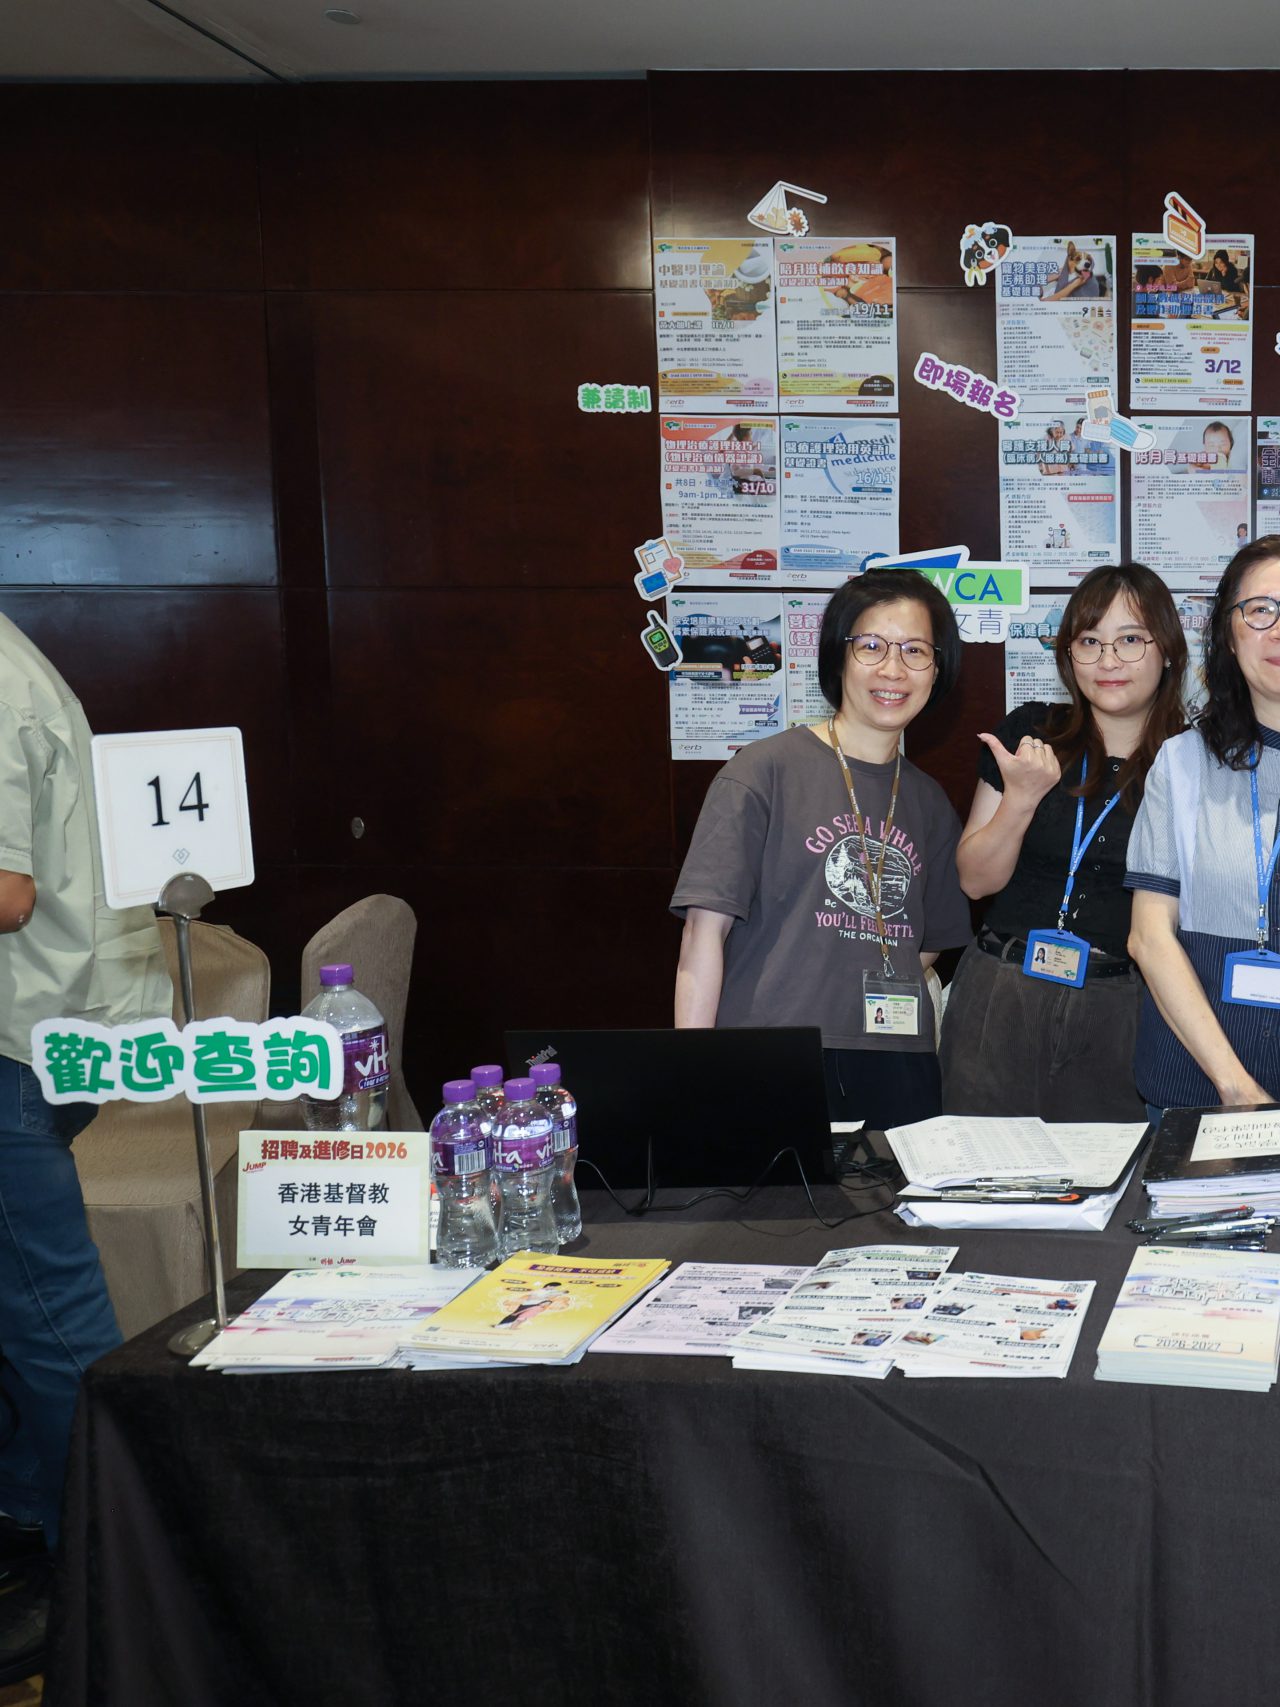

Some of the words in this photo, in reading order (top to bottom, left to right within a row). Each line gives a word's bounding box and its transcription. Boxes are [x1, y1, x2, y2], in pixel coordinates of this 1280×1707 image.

[852, 303, 890, 316] 19/11
[1204, 359, 1242, 374] 3/12
[581, 387, 649, 410] 兼讀制
[918, 357, 1017, 418] 即場報名
[741, 481, 775, 494] 31/10
[147, 771, 210, 828] 14
[805, 825, 836, 855] GO
[864, 816, 873, 837] A
[815, 911, 858, 930] YOU'LL
[838, 929, 857, 940] THE
[44, 1029, 331, 1095] 歡迎查詢
[277, 1182, 390, 1205] 香港基督教
[288, 1215, 378, 1238] 女青年會
[1155, 1338, 1222, 1351] 2026-2027
